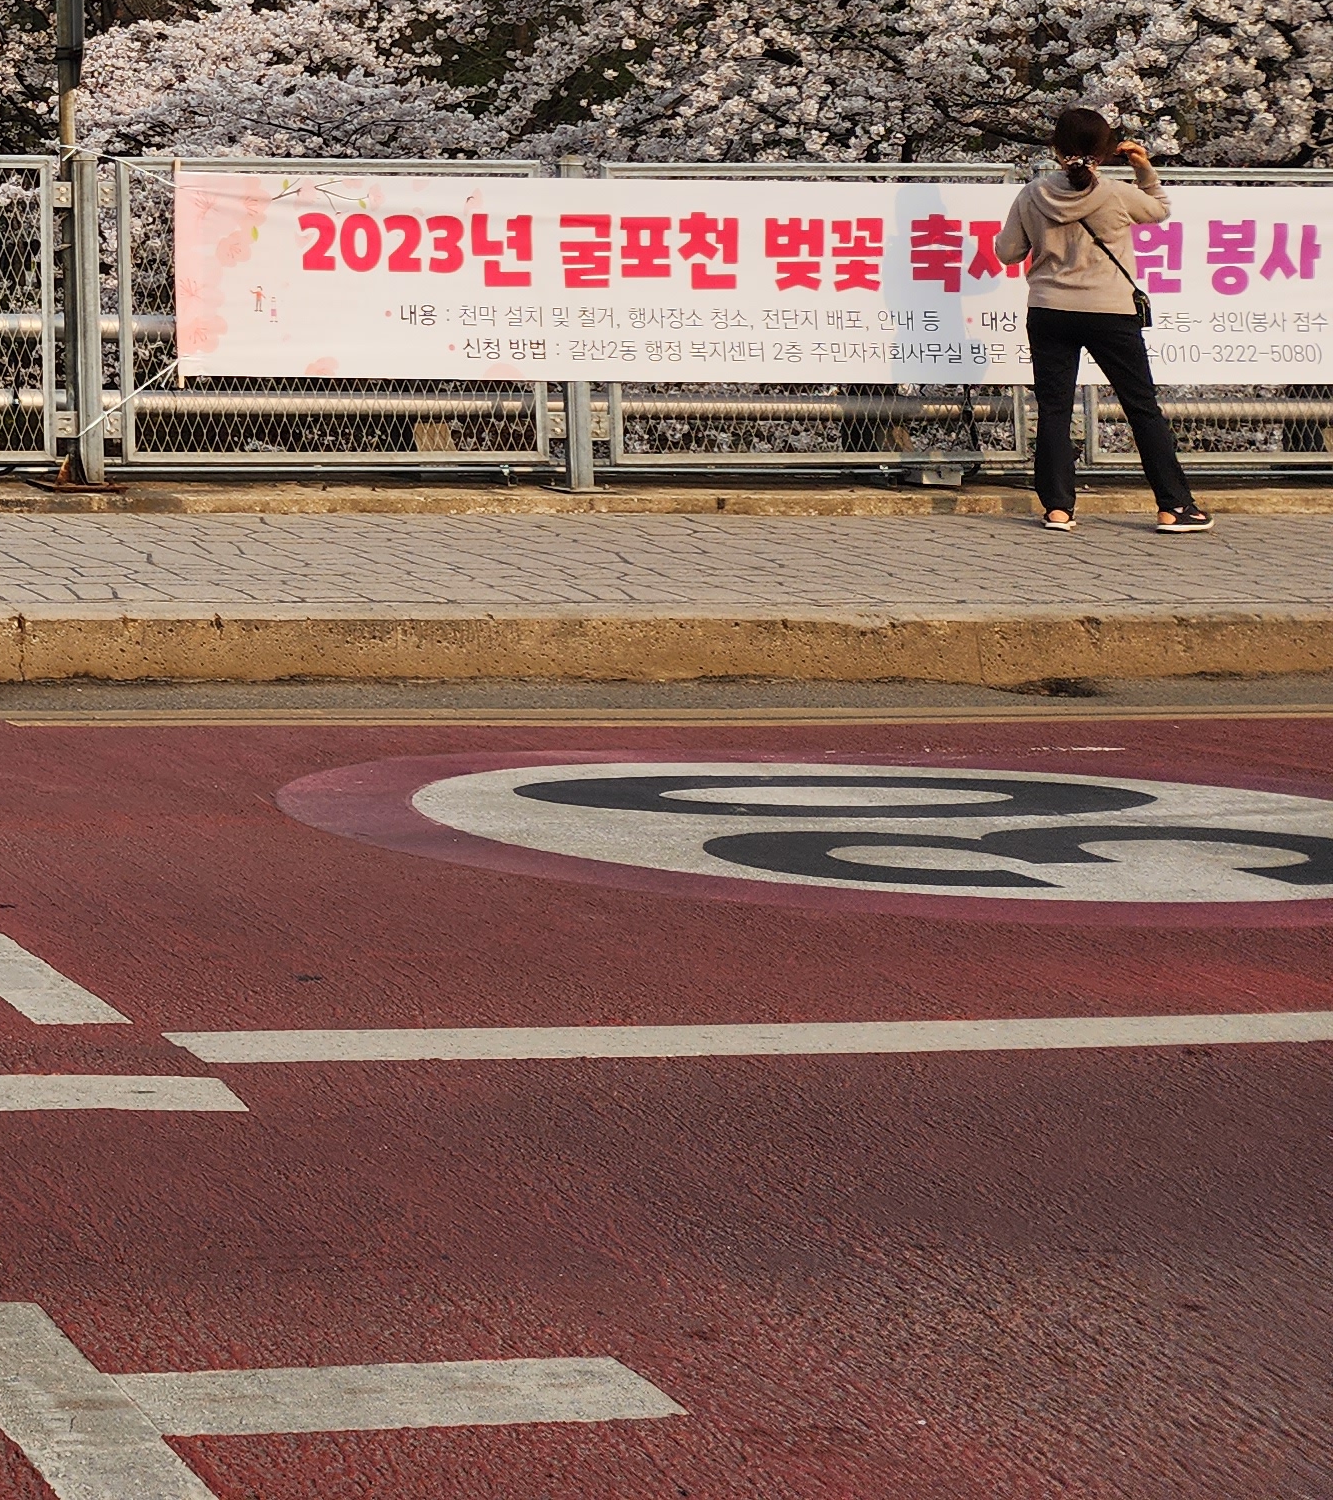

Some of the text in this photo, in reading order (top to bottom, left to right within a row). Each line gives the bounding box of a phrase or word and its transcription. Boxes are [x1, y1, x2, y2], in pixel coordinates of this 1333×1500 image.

[297, 212, 533, 287] 2023년
[559, 211, 739, 290] 굴포천
[764, 217, 884, 292] 벚꽃
[1130, 221, 1183, 293] 원
[1206, 219, 1322, 295] 봉사
[399, 304, 438, 326] 내용
[458, 305, 497, 328] 천막
[504, 306, 544, 328] 설치
[552, 306, 570, 328] 및
[577, 306, 621, 329] 철거,
[628, 307, 704, 330] 행사장소
[710, 308, 754, 330] 청소,
[761, 309, 818, 331] 전단지
[826, 309, 870, 332] 배포,
[877, 310, 915, 332] 안내
[921, 311, 941, 332] 등
[981, 311, 1018, 332] 대상
[1293, 312, 1329, 333] 점수
[462, 337, 501, 360] 신청
[509, 338, 547, 360] 방법
[569, 339, 637, 362] 갈산2동
[644, 340, 682, 362] 행정
[690, 341, 766, 363] 복지센터
[772, 341, 804, 363] 2층
[809, 341, 963, 364] 주민자치회사무실
[970, 343, 1008, 364] 방문
[1015, 343, 1033, 364] 접
[1146, 342, 1323, 366] 수(010-3222-5080)
